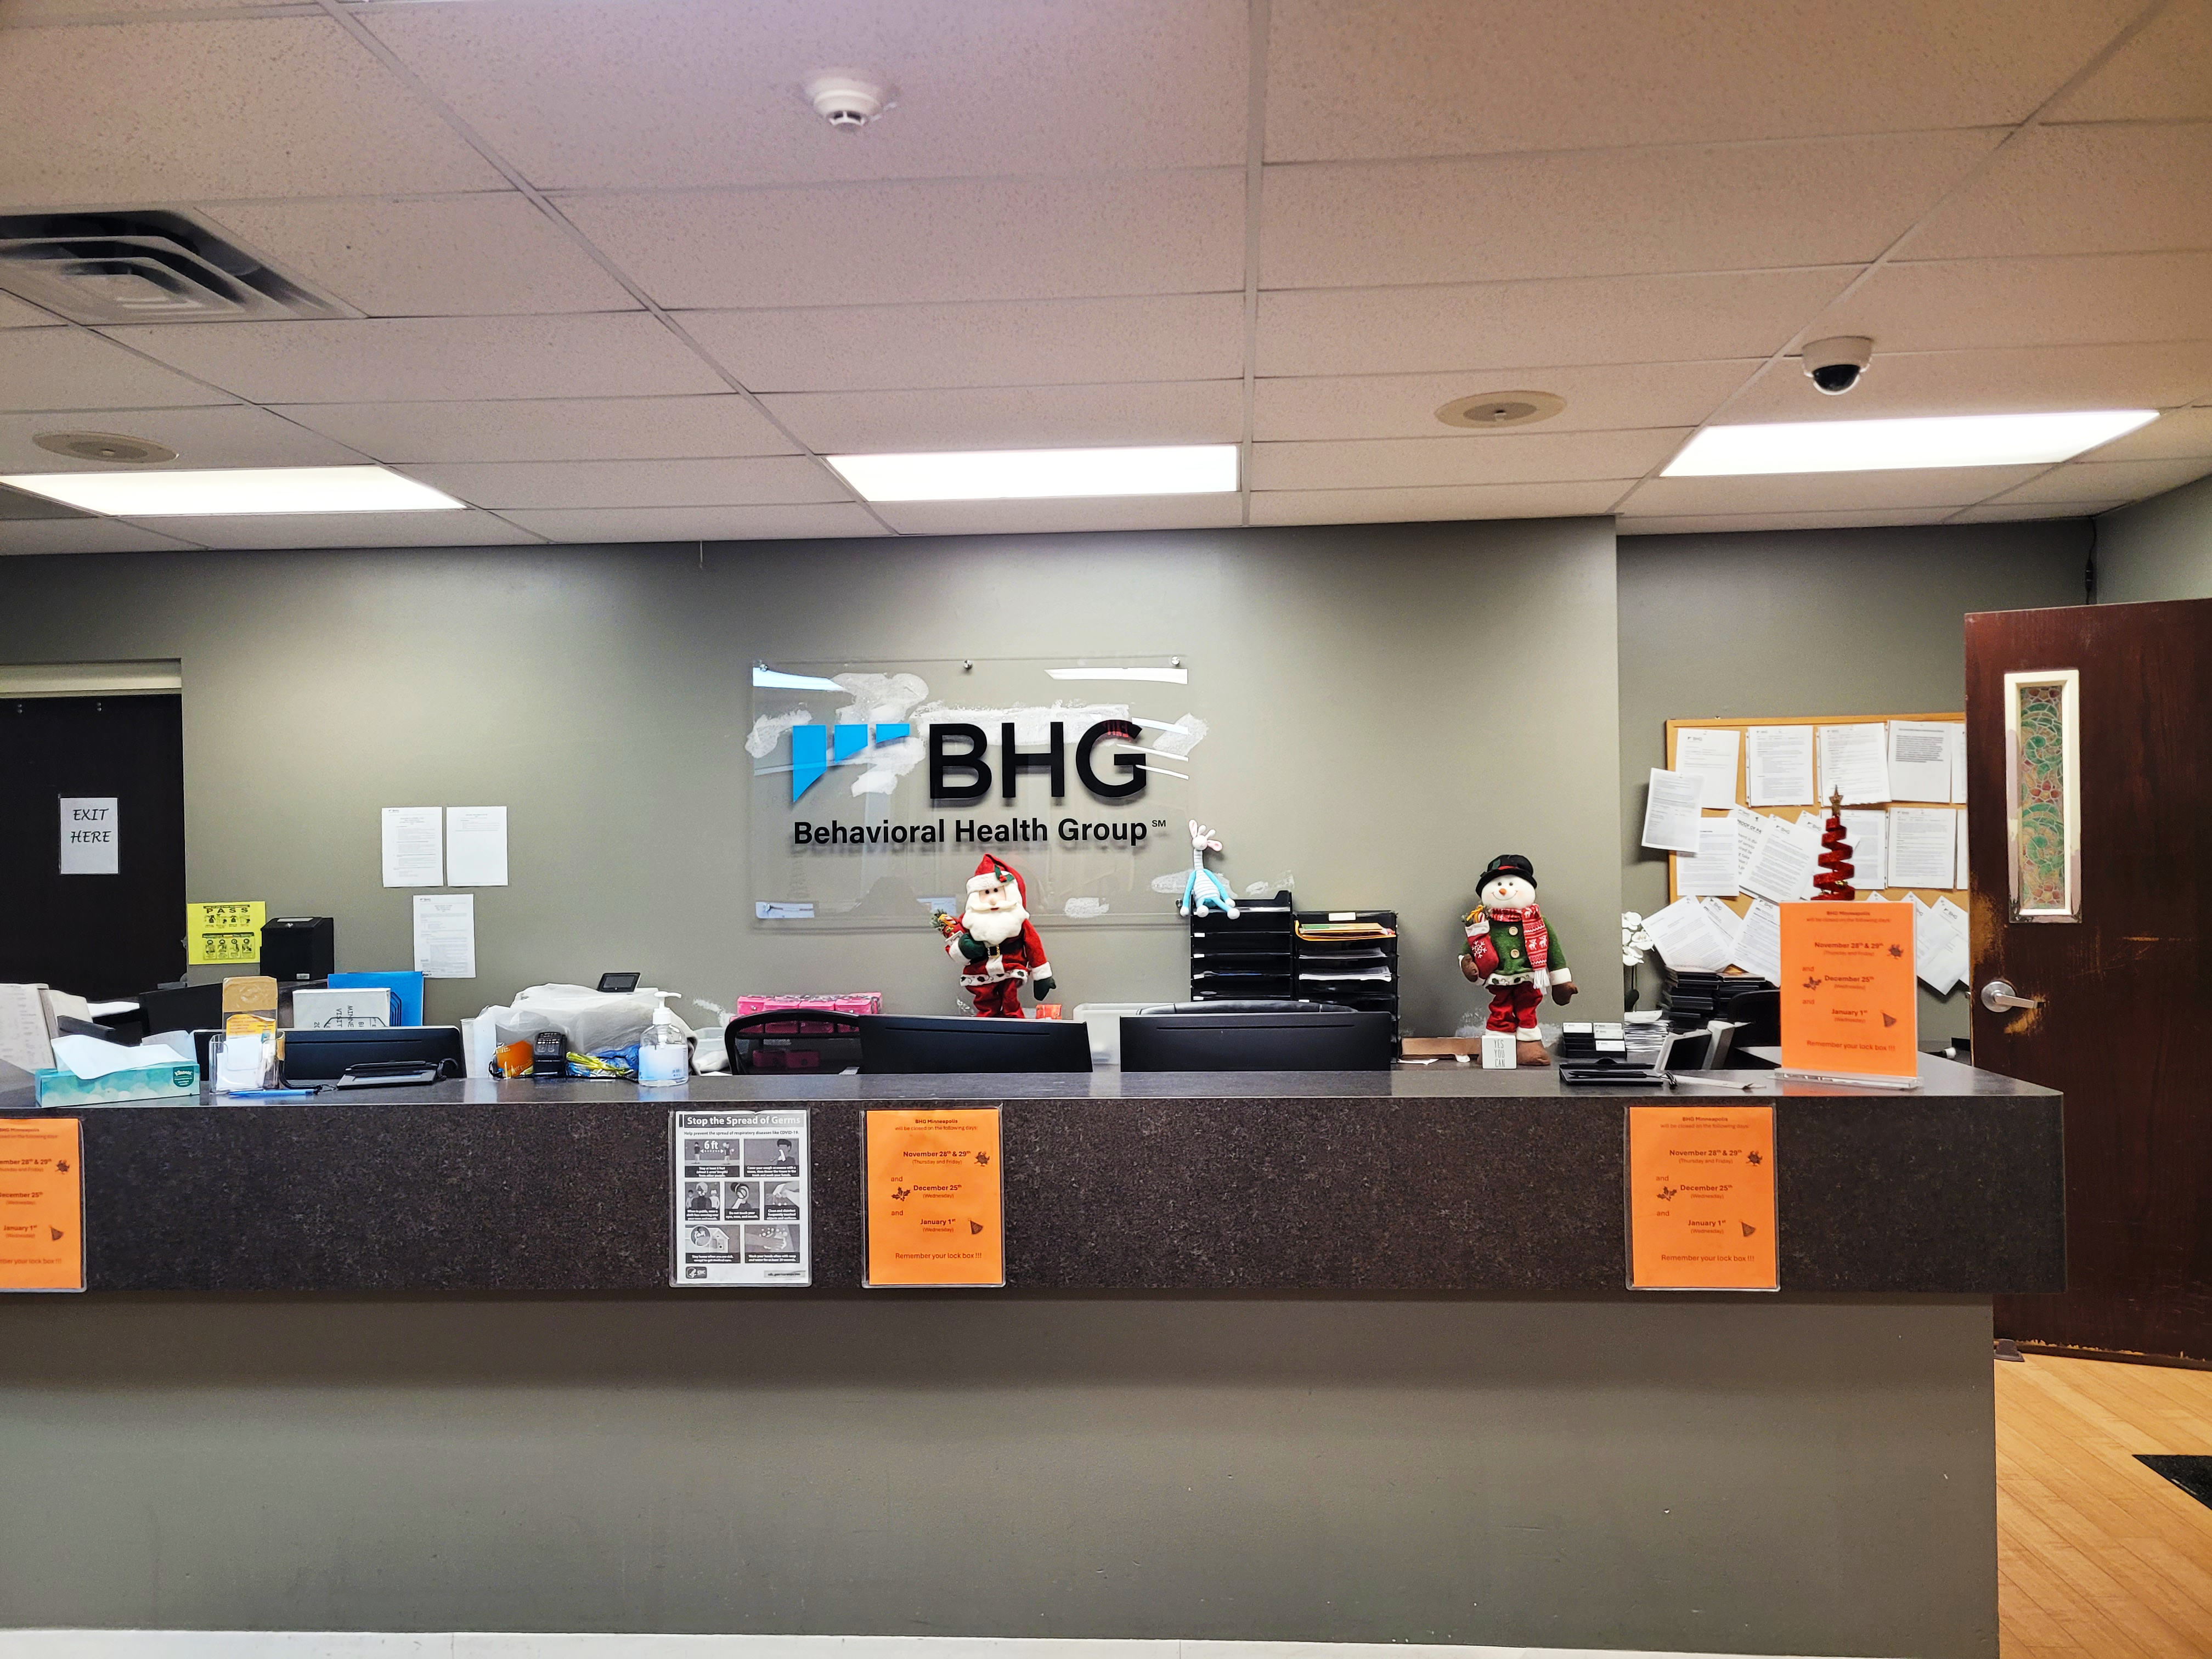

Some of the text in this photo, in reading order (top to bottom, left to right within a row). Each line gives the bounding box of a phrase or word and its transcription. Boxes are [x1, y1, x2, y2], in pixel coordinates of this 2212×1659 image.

[929, 719, 1147, 799] BHG
[73, 808, 109, 820] EXIT
[70, 830, 111, 843] HERE
[794, 819, 944, 844] Behavioral
[955, 818, 1048, 842] Health
[1058, 820, 1147, 845] Group
[1494, 1040, 1504, 1048] YES
[1807, 1040, 1842, 1048] Remember
[1494, 1049, 1505, 1058] YOU
[1495, 1058, 1505, 1067] CAN
[687, 1115, 800, 1126] Stop the Spread of Germs
[704, 1141, 719, 1149] 6 ft
